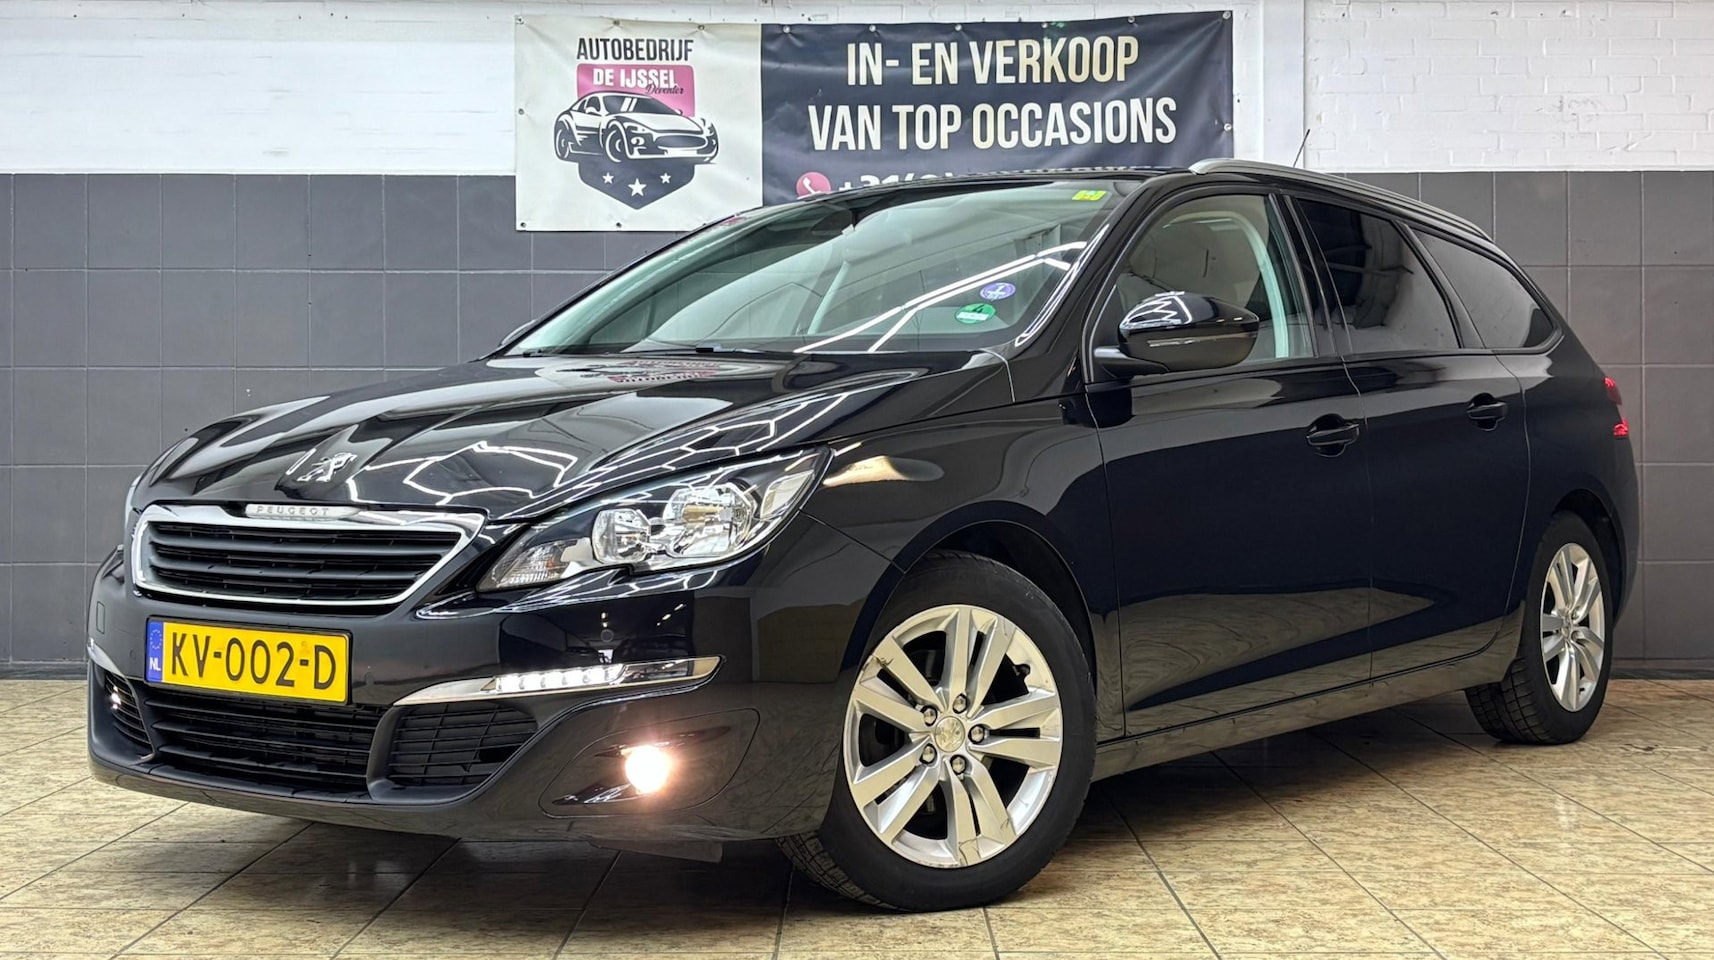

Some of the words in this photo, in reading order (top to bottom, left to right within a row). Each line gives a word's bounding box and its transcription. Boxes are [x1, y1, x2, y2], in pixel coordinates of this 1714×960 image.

[576, 37, 695, 62] AUTOBEDRIJF
[846, 42, 900, 86] IN-
[911, 41, 960, 86] EN
[969, 35, 1139, 85] VERKOOP
[593, 68, 614, 86] DE
[620, 68, 677, 89] IJSSEL
[645, 83, 684, 95] Deventer
[808, 104, 882, 151] VAN
[891, 103, 962, 151] TOP
[972, 97, 1177, 150] OCCASIONS
[256, 505, 330, 515] PEUGEOT
[149, 657, 162, 671] NL
[171, 632, 336, 690] KV-002-D
